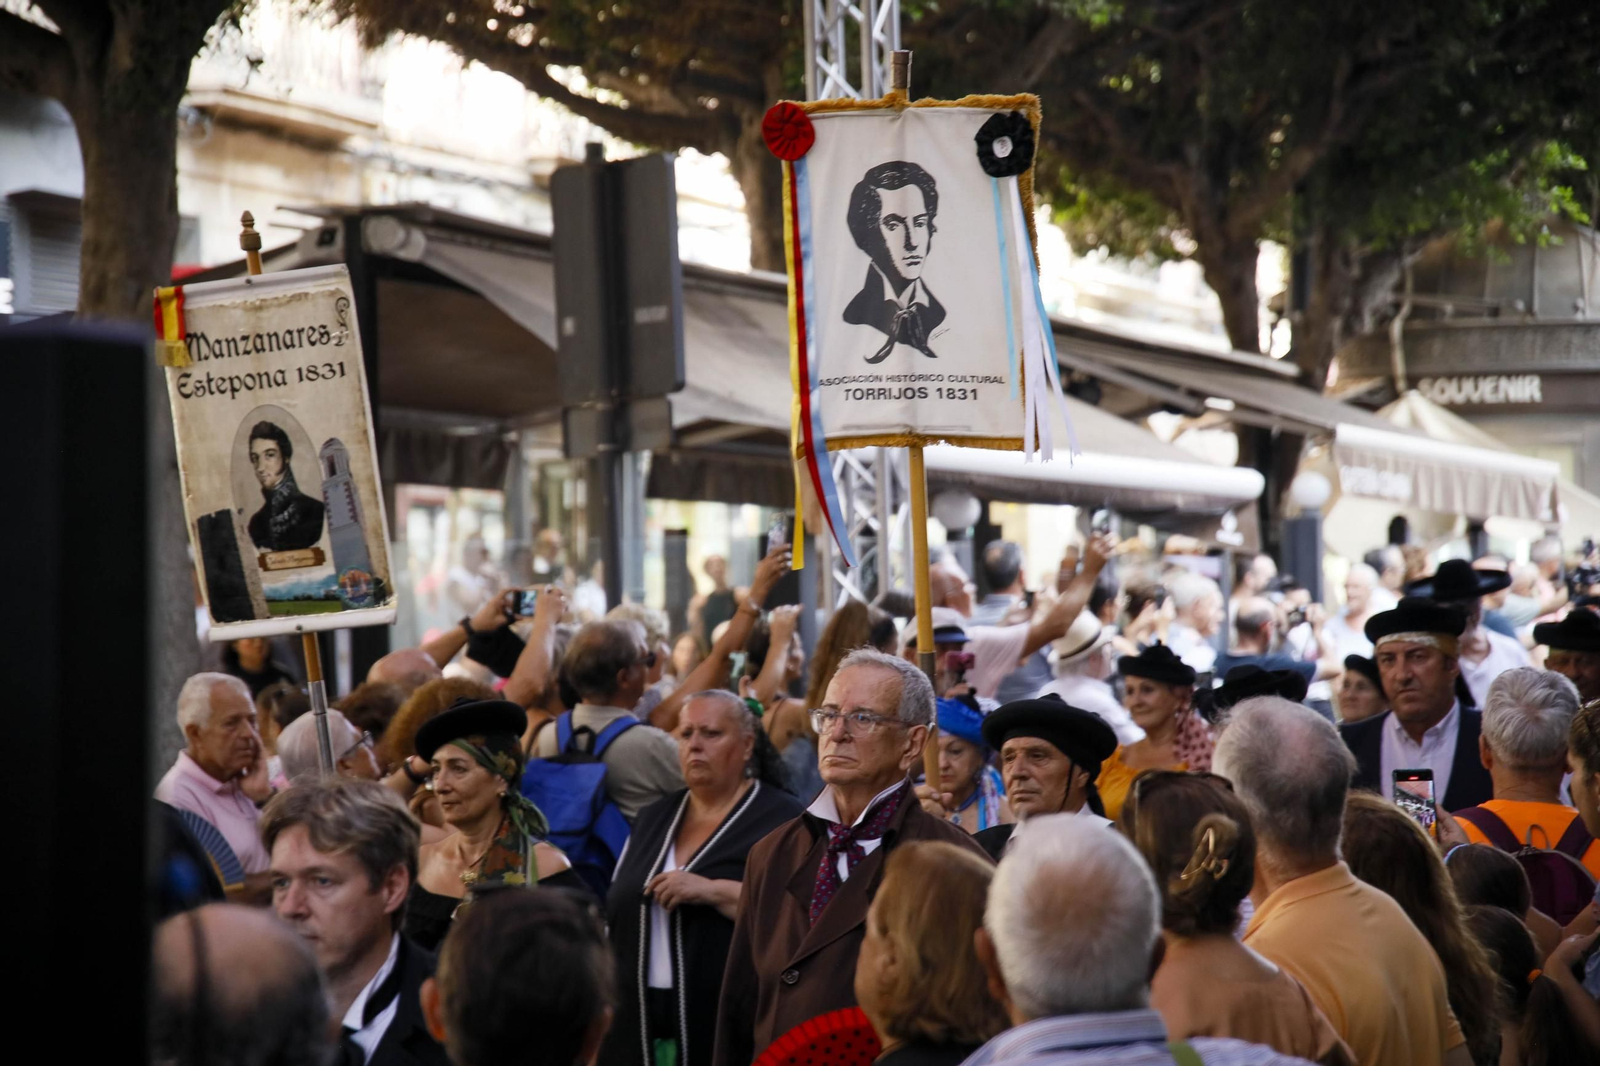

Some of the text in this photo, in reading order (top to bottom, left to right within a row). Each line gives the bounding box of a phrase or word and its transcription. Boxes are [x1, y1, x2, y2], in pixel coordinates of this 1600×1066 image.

[185, 323, 332, 362] Manzanares
[176, 360, 347, 400] Estepona 1831
[818, 372, 1006, 387] ASOCIACIÓN HISTÓRICO CULTURAL
[844, 386, 979, 401] TORRIJOS 1831
[1418, 375, 1542, 404] SOUVENIR
